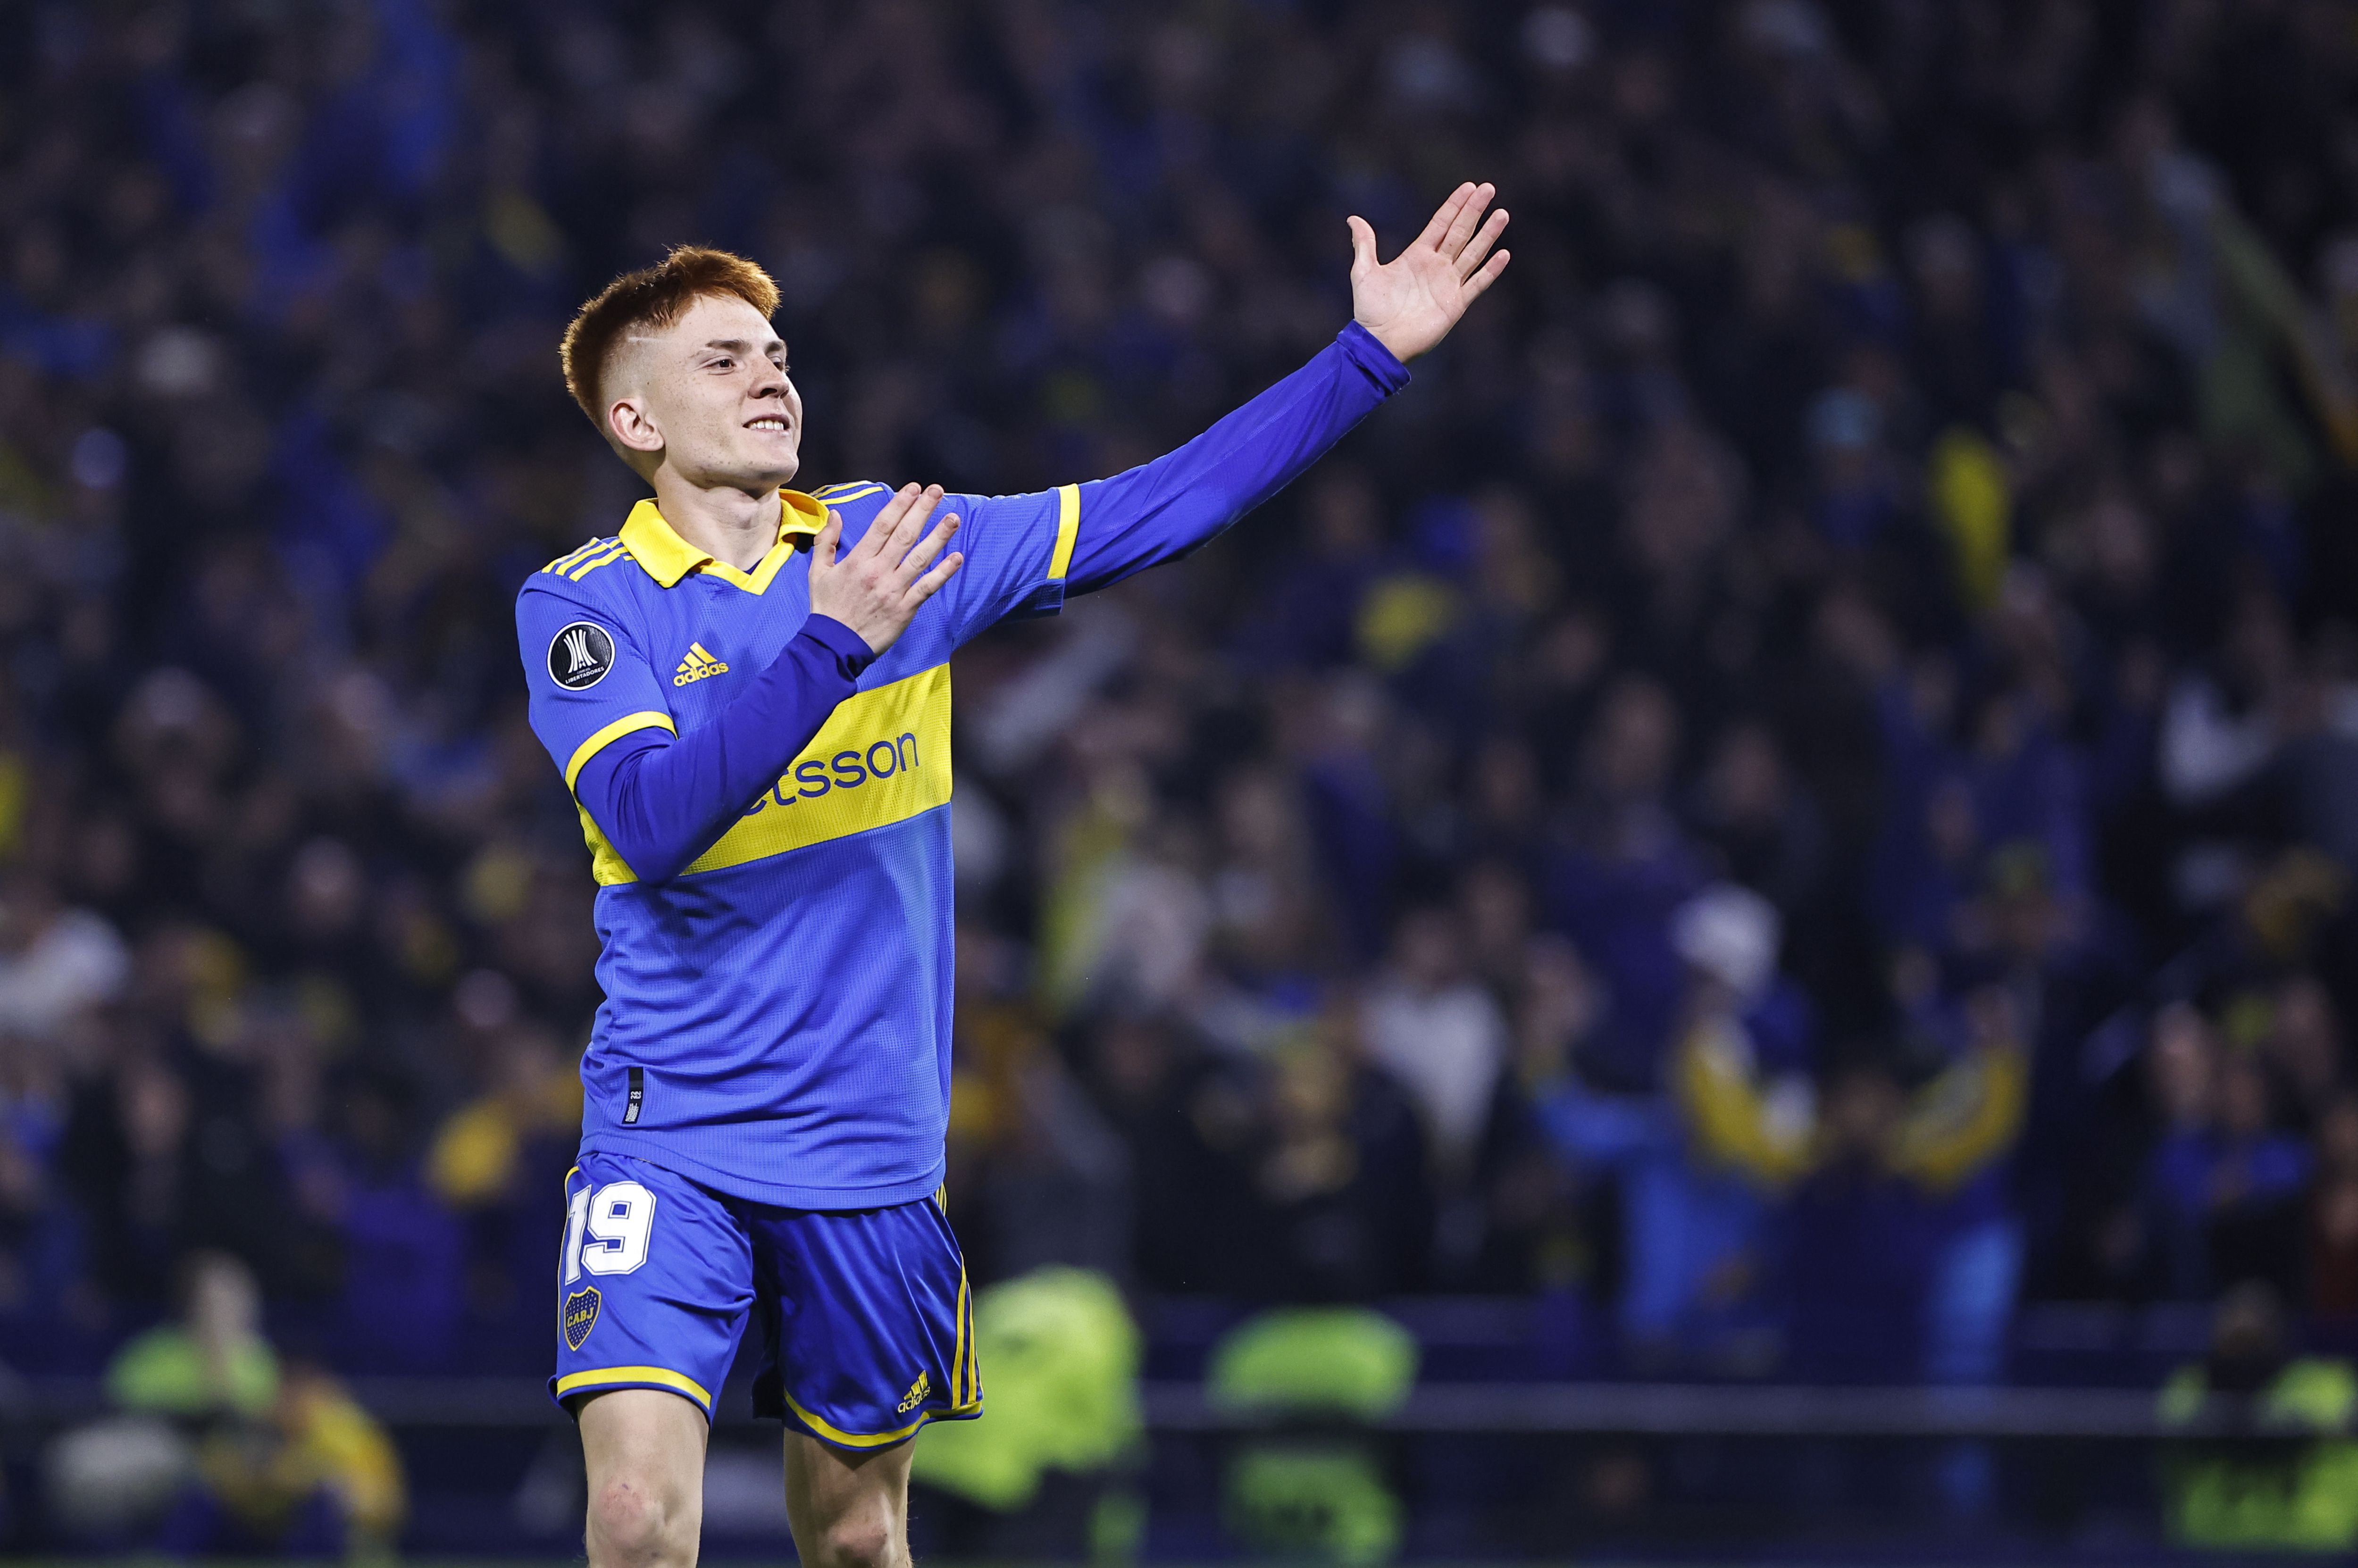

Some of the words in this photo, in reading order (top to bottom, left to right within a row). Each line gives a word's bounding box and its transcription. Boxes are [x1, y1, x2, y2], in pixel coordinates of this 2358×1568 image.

[565, 666, 605, 684] LIBERTADORES
[673, 662, 729, 687] adidas
[744, 732, 919, 816] tsson
[565, 1180, 657, 1286] 19
[567, 1307, 594, 1327] CABJ
